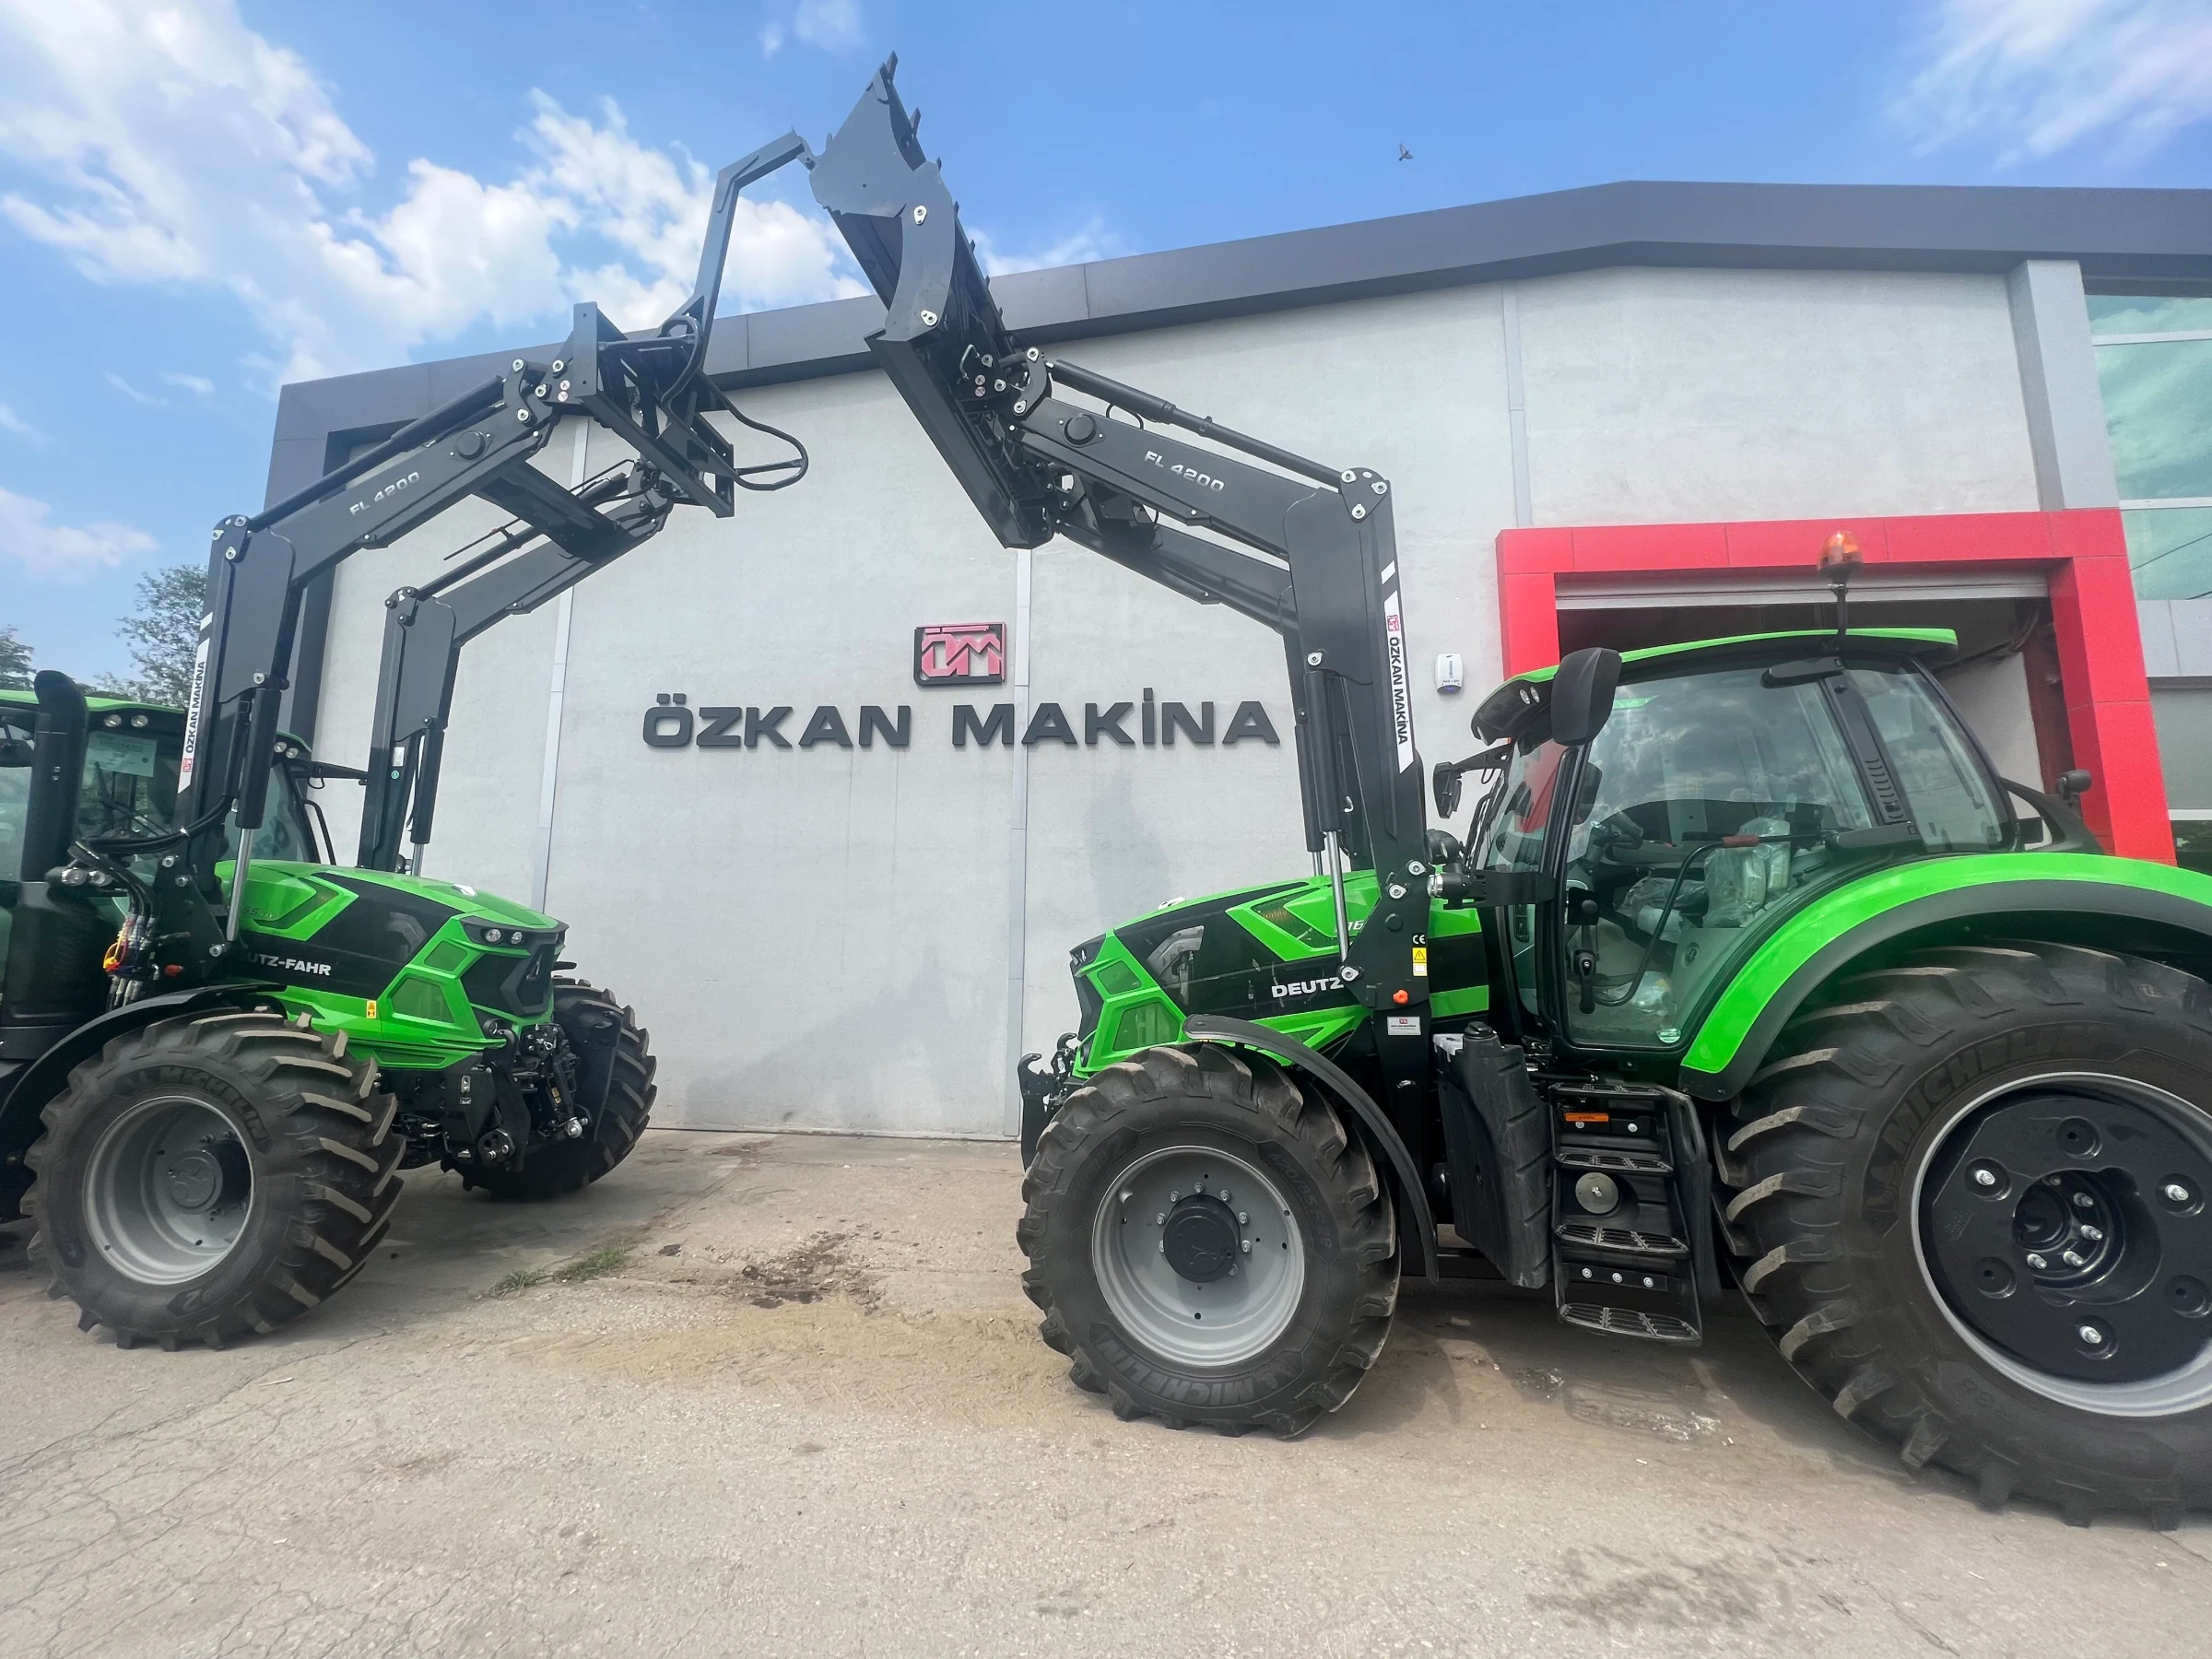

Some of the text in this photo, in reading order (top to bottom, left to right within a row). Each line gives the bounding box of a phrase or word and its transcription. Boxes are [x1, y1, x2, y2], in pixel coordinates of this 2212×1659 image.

[349, 471, 420, 516] FL 4200
[1144, 450, 1225, 492] FL 4200
[185, 712, 198, 754] ÖZKAN
[192, 661, 206, 709] MAKİNA
[642, 687, 1281, 748] ÖZKAN MAKİNA
[1389, 637, 1408, 745] ÖZKAN MAKİNA
[248, 951, 332, 976] UTZ-FAHR
[1412, 934, 1426, 945] CE
[159, 1066, 269, 1139] MICHELIN
[1095, 1335, 1255, 1406] MICHELIN
